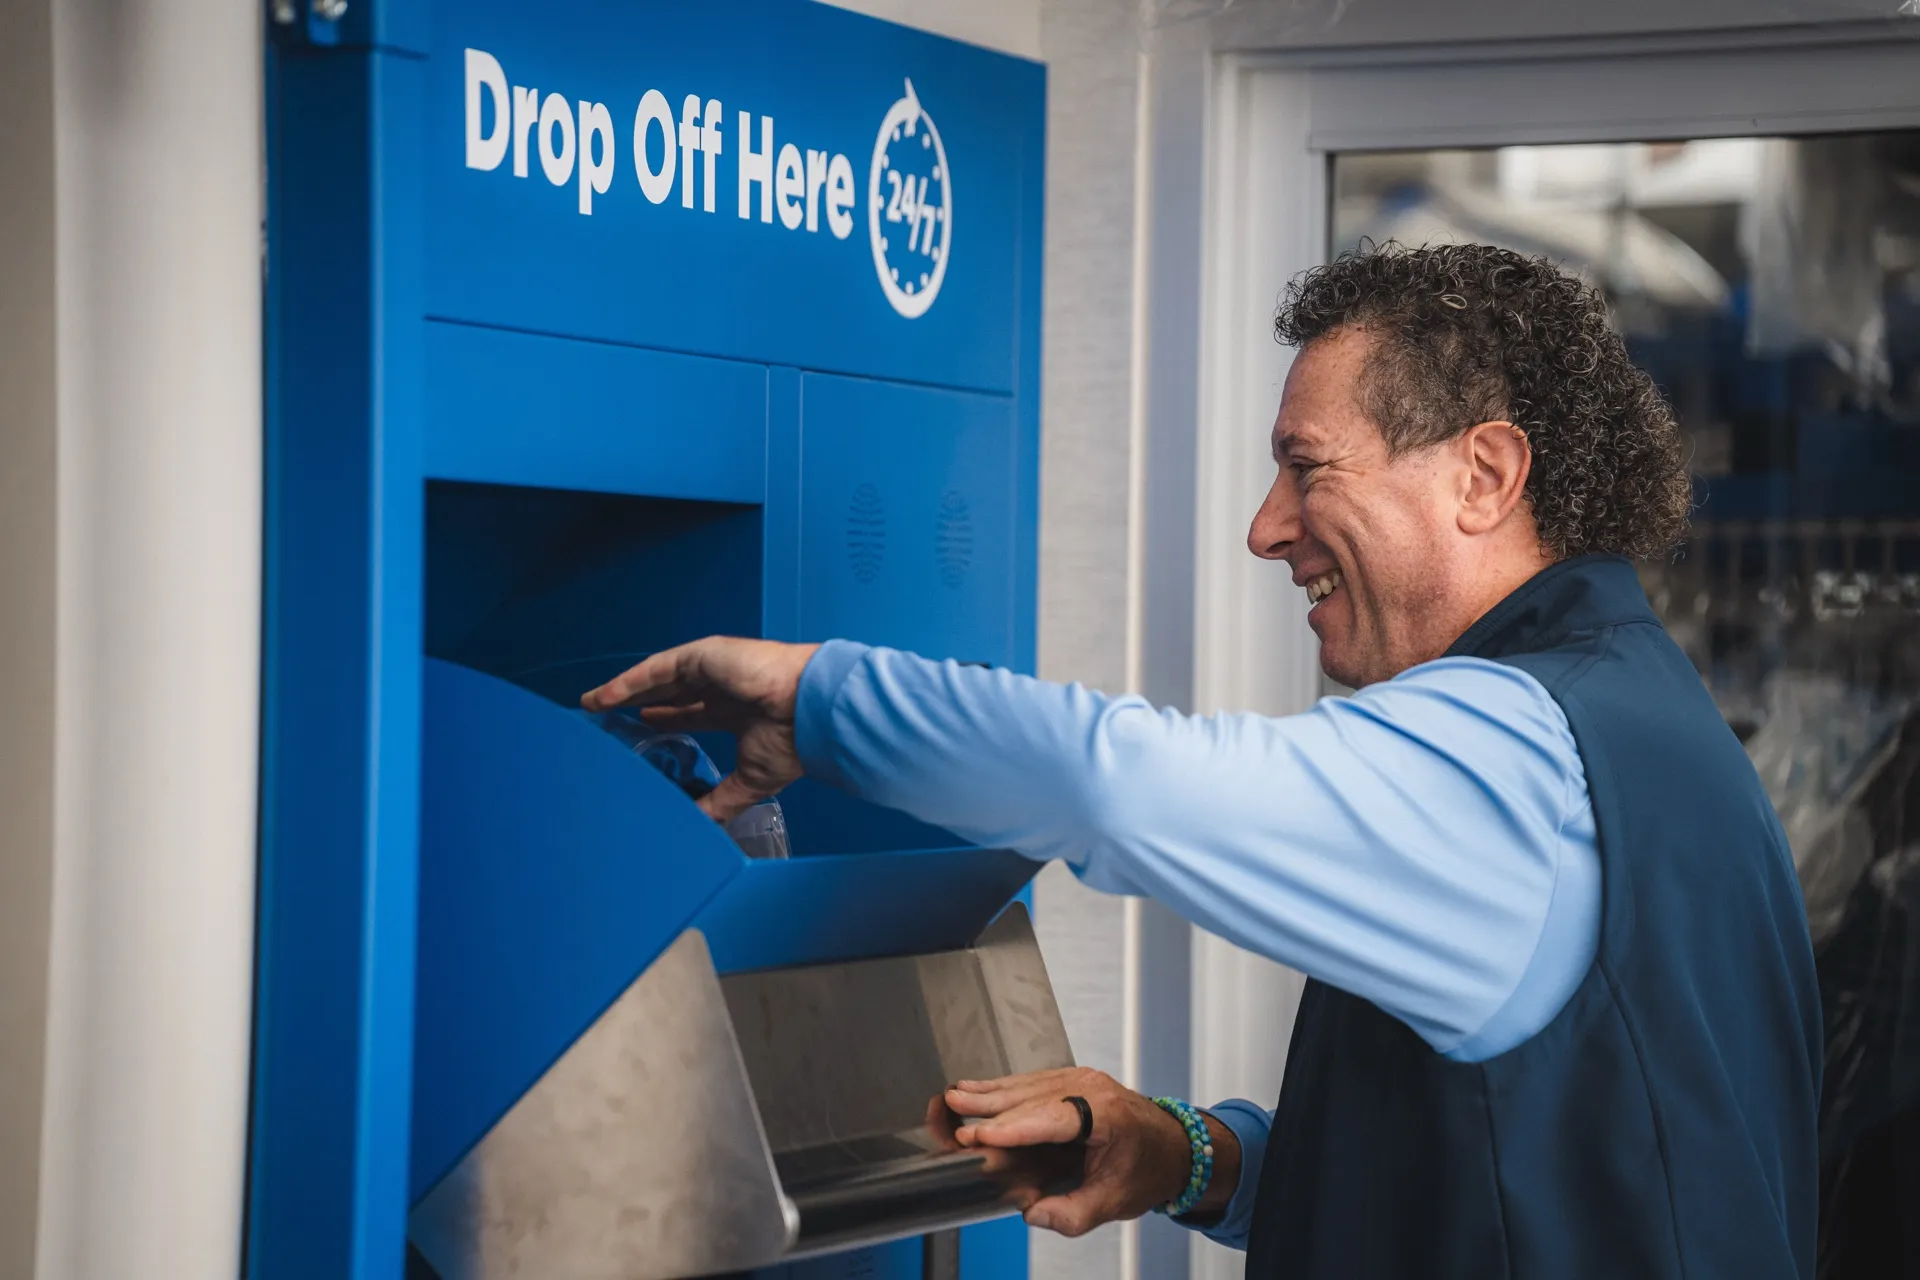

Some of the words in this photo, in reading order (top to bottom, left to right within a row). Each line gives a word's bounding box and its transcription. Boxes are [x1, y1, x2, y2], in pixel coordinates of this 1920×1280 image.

[465, 48, 615, 216] Drop
[633, 89, 722, 213] Off
[738, 110, 855, 239] Here
[887, 170, 936, 256] 24/7
